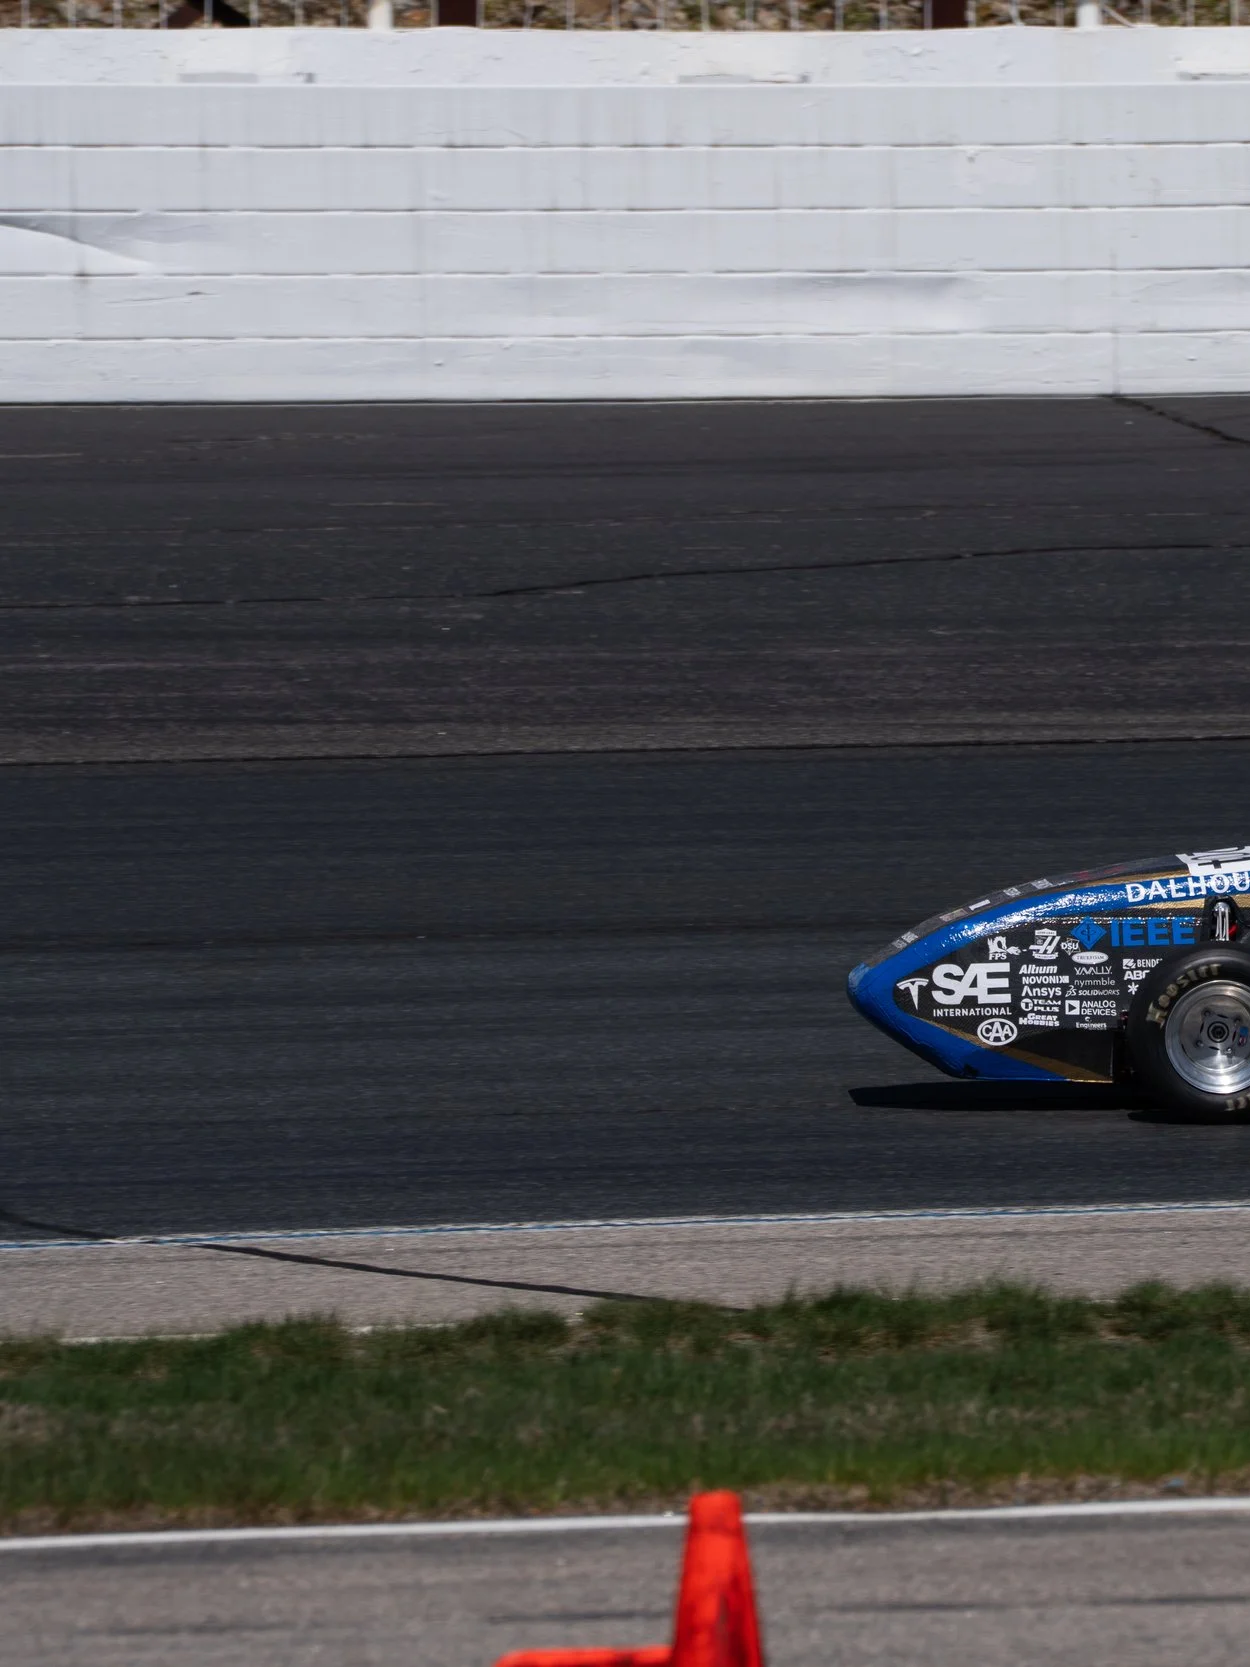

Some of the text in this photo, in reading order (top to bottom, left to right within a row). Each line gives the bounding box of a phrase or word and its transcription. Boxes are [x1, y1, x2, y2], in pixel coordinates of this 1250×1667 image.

[1111, 918, 1196, 947] IEEE
[1061, 941, 1079, 951] DSU
[988, 952, 1008, 961] FPS
[1018, 964, 1058, 975] Altium
[931, 962, 1012, 1006] SAE
[1022, 975, 1070, 985] NOVONIX
[1074, 977, 1116, 988] nymmble
[1021, 985, 1062, 998] Ansys
[1033, 998, 1062, 1006] TEAM
[1081, 1000, 1116, 1009] ANALOG
[932, 1007, 1013, 1018] INTERNATIONAL
[1081, 1008, 1117, 1016] DEVICES
[1075, 1021, 1107, 1029] Engineers
[981, 1020, 1013, 1042] CAA
